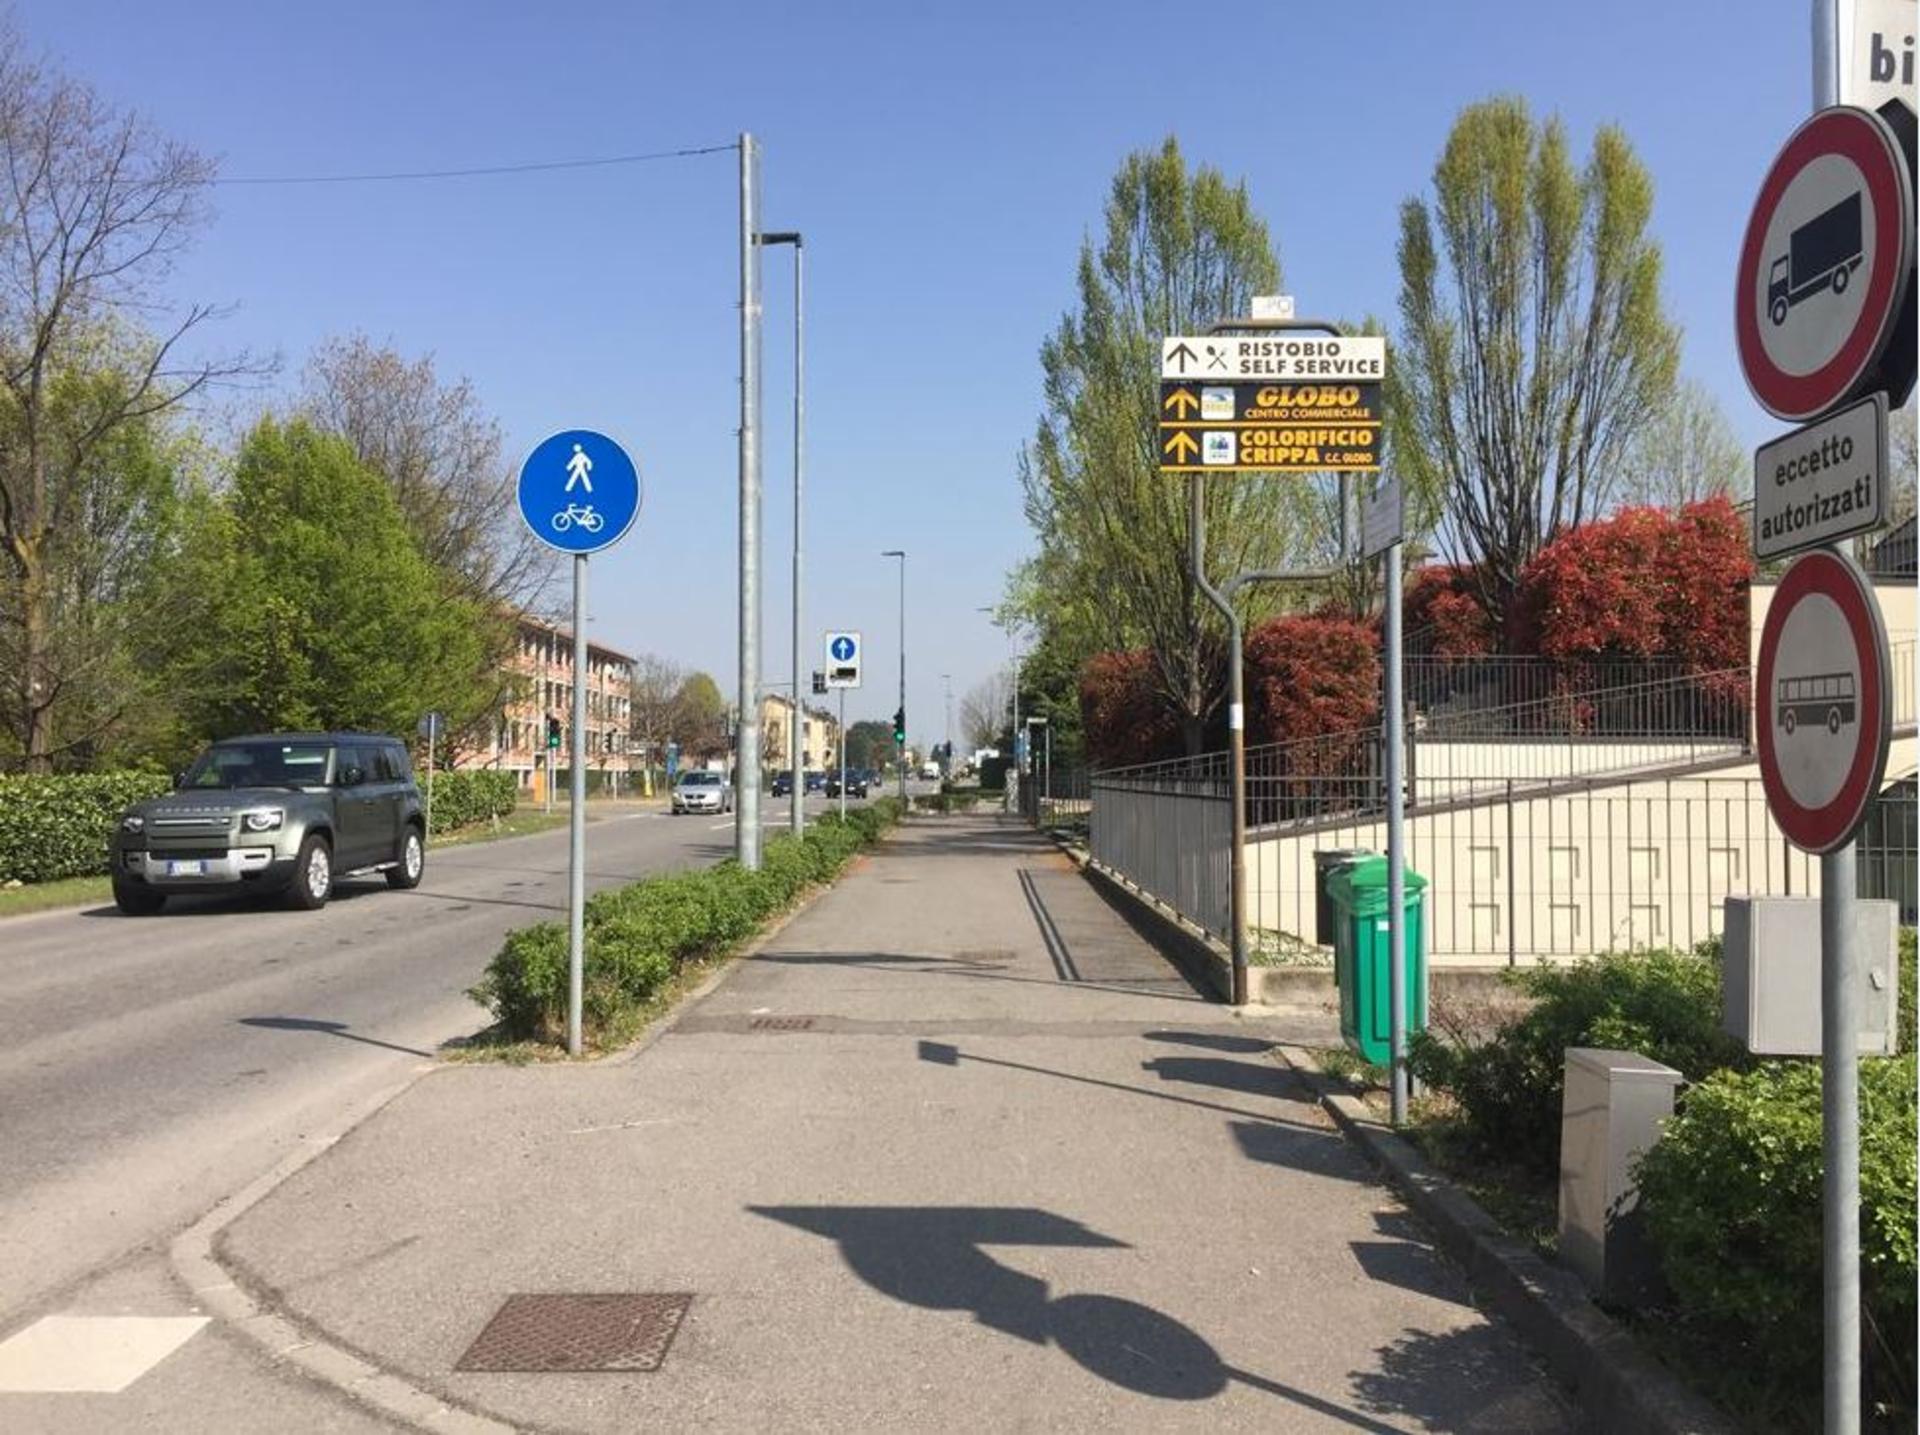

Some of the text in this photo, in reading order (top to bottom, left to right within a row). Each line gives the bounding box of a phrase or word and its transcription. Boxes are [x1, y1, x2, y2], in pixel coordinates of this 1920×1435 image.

[1871, 32, 1915, 85] bi
[1239, 343, 1340, 356] RISTOBIO
[1240, 359, 1380, 374] SELF SERVICE
[1256, 386, 1360, 407] GLOBO
[1244, 408, 1371, 419] CENTRO COMMERCIALE
[1240, 430, 1373, 446] COLORIFICIO
[1240, 448, 1320, 464] CRIPPA
[1776, 434, 1854, 488] eccetto
[1762, 474, 1871, 540] autorizzati
